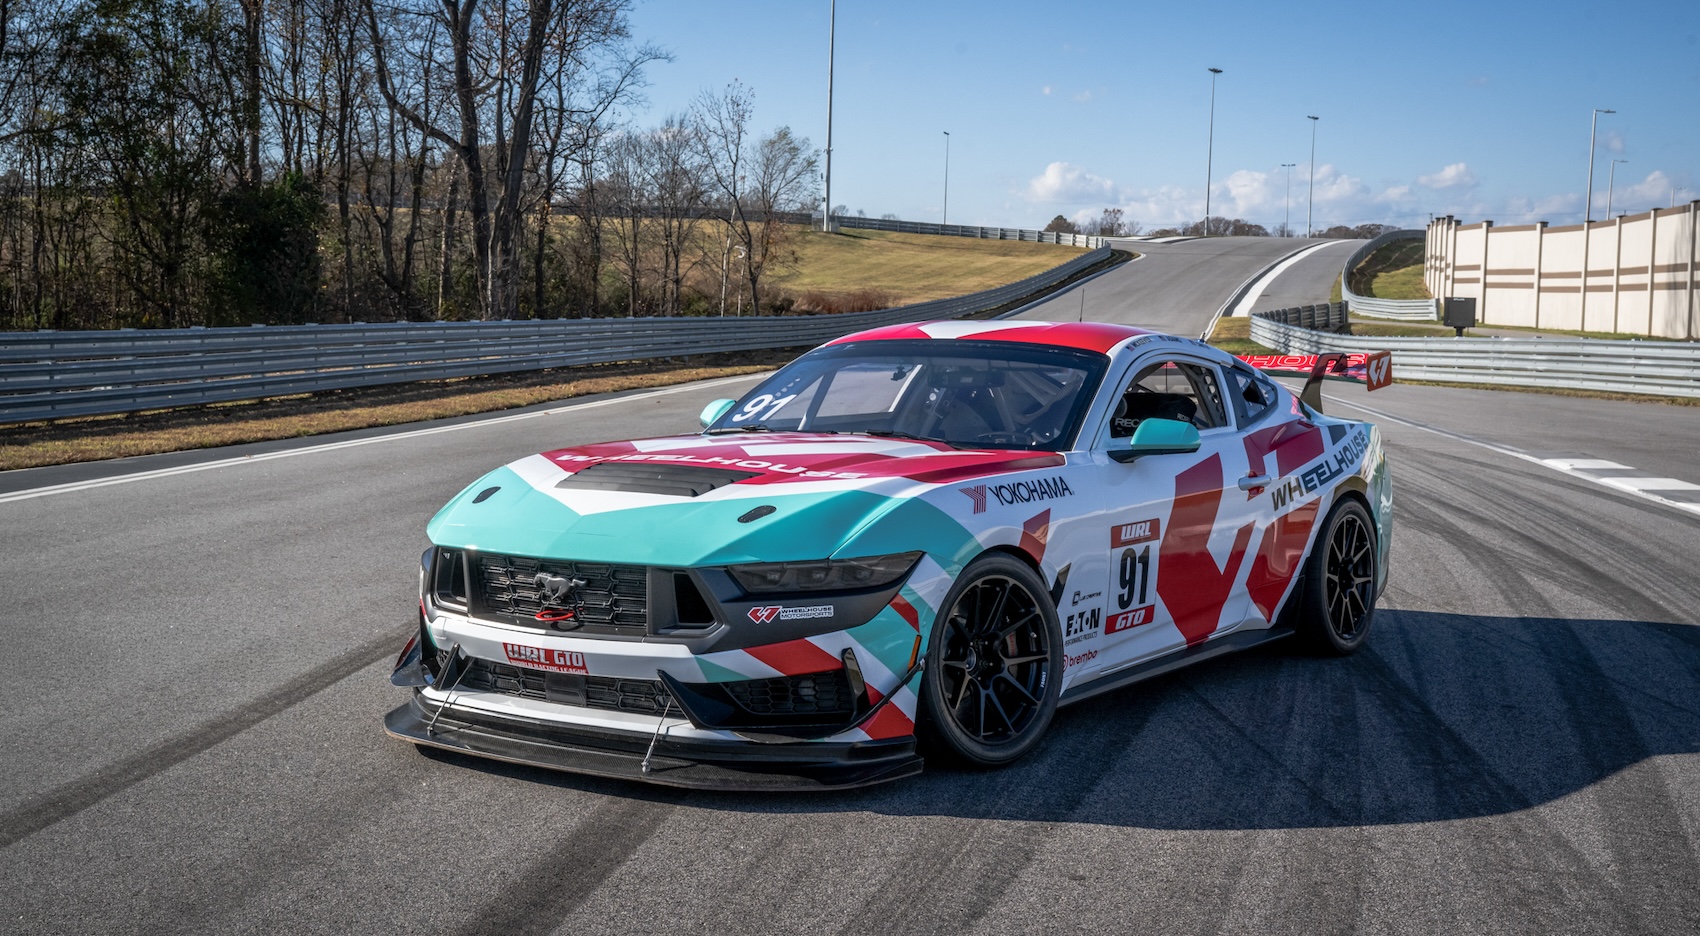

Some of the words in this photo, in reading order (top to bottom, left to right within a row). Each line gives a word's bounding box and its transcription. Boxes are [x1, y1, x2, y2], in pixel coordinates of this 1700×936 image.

[732, 394, 797, 422] 91
[556, 454, 869, 479] WHEELHOUSE
[1271, 430, 1369, 511] WHEELHOUSE
[988, 476, 1072, 505] YOKOHAMA
[1121, 521, 1152, 540] WRL
[1117, 545, 1150, 610] 91
[781, 606, 833, 614] WHEELHOUSE
[781, 611, 833, 619] MOTORSPORTS
[1066, 607, 1101, 637] EATON
[1115, 609, 1146, 631] GTO
[1083, 631, 1099, 641] PRODUCTS
[507, 643, 550, 664] WRL
[553, 650, 584, 667] GTO
[1069, 649, 1098, 667] brembo
